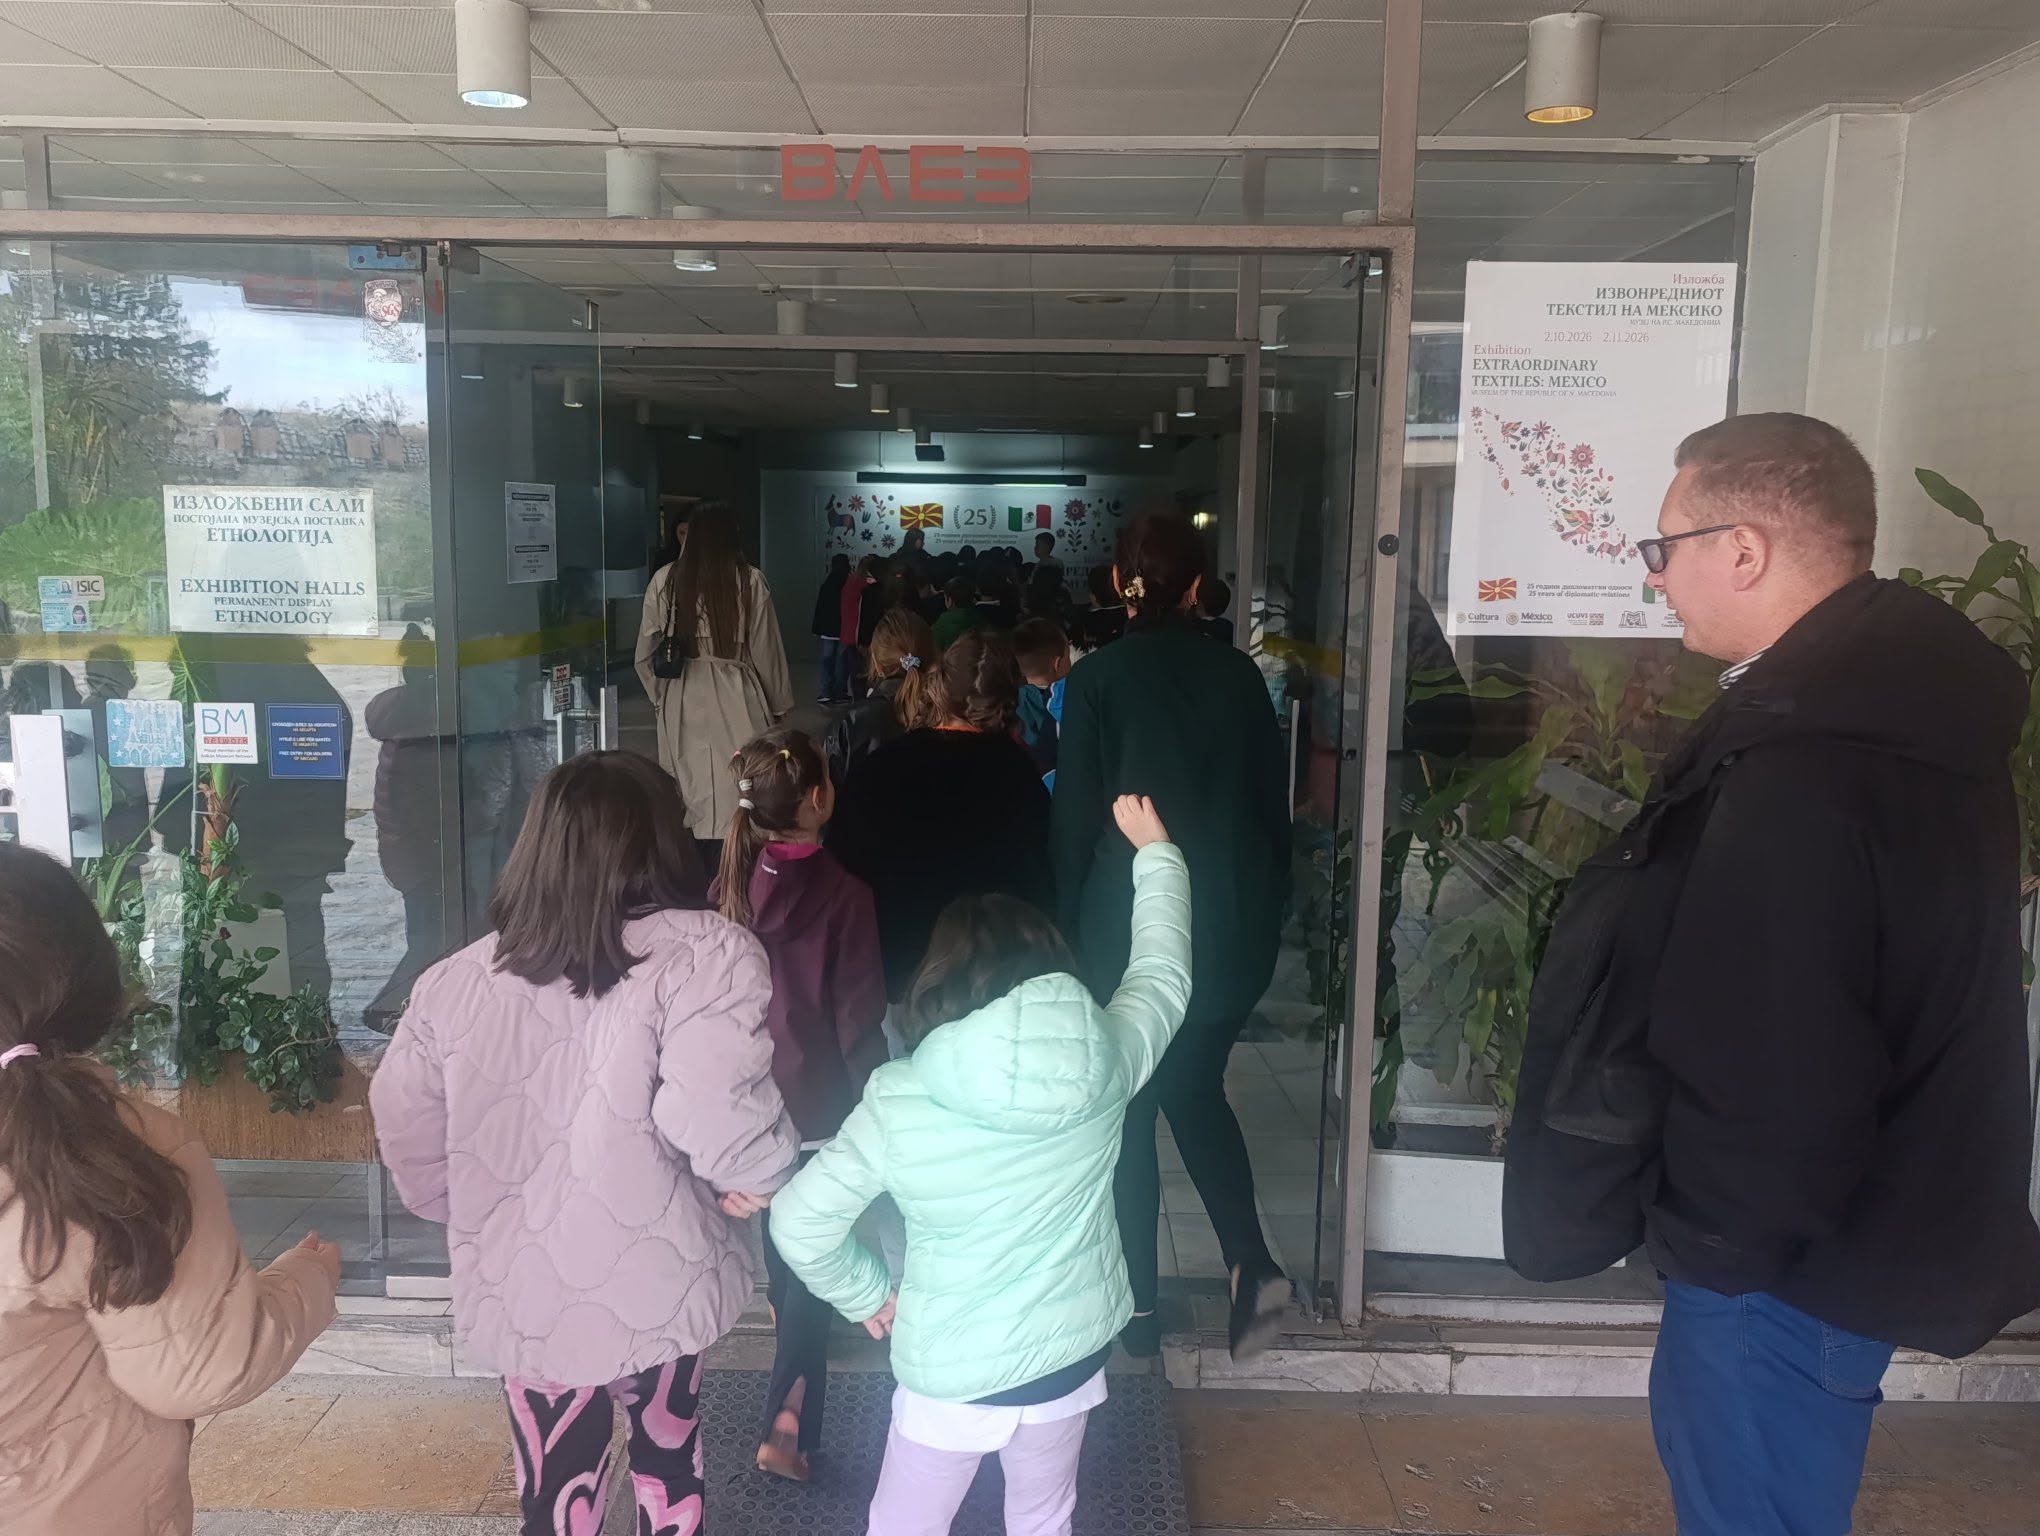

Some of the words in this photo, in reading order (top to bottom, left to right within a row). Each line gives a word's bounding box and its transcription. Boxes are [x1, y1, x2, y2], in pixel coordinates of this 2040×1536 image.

[780, 144, 1030, 204] ВЛЕЗ
[1673, 273, 1725, 285] Изложба
[1595, 287, 1725, 302] ИЗВОНРЕДНИОТ
[382, 304, 400, 316] SGS
[1546, 303, 1617, 317] ТЕКСТИЛ
[1621, 304, 1643, 317] НА
[1646, 304, 1723, 317] МЕКСИКО
[1544, 331, 1592, 342] 2.10.2026
[1602, 332, 1650, 343] 2.11.2026
[1474, 344, 1531, 355] Exhibition
[1472, 358, 1599, 372] EXTRAORDINARY
[1472, 375, 1545, 388] TEXTILES:
[1548, 375, 1608, 389] MEXICO
[172, 495, 304, 511] ИЗЛОЖБЕНИ
[309, 498, 365, 513] САЛИ
[173, 514, 239, 526] ПОСТОЈАНА
[243, 515, 300, 527] МУЗЕЈСКА
[304, 516, 365, 526] ПОСТАВКА
[963, 508, 987, 526] 25
[207, 527, 333, 547] ЕТНОЛОГИЈА
[76, 580, 101, 593] ISIC
[181, 579, 299, 596] EXHIBITION
[305, 580, 366, 596] HALLS
[214, 597, 285, 607] PERMANENT
[288, 597, 334, 608] DISPLAY
[215, 610, 334, 625] ETHNOLOGY
[1467, 612, 1499, 621] Cultura
[1521, 612, 1553, 621] México
[201, 708, 248, 735] BM
[204, 737, 248, 745] network
